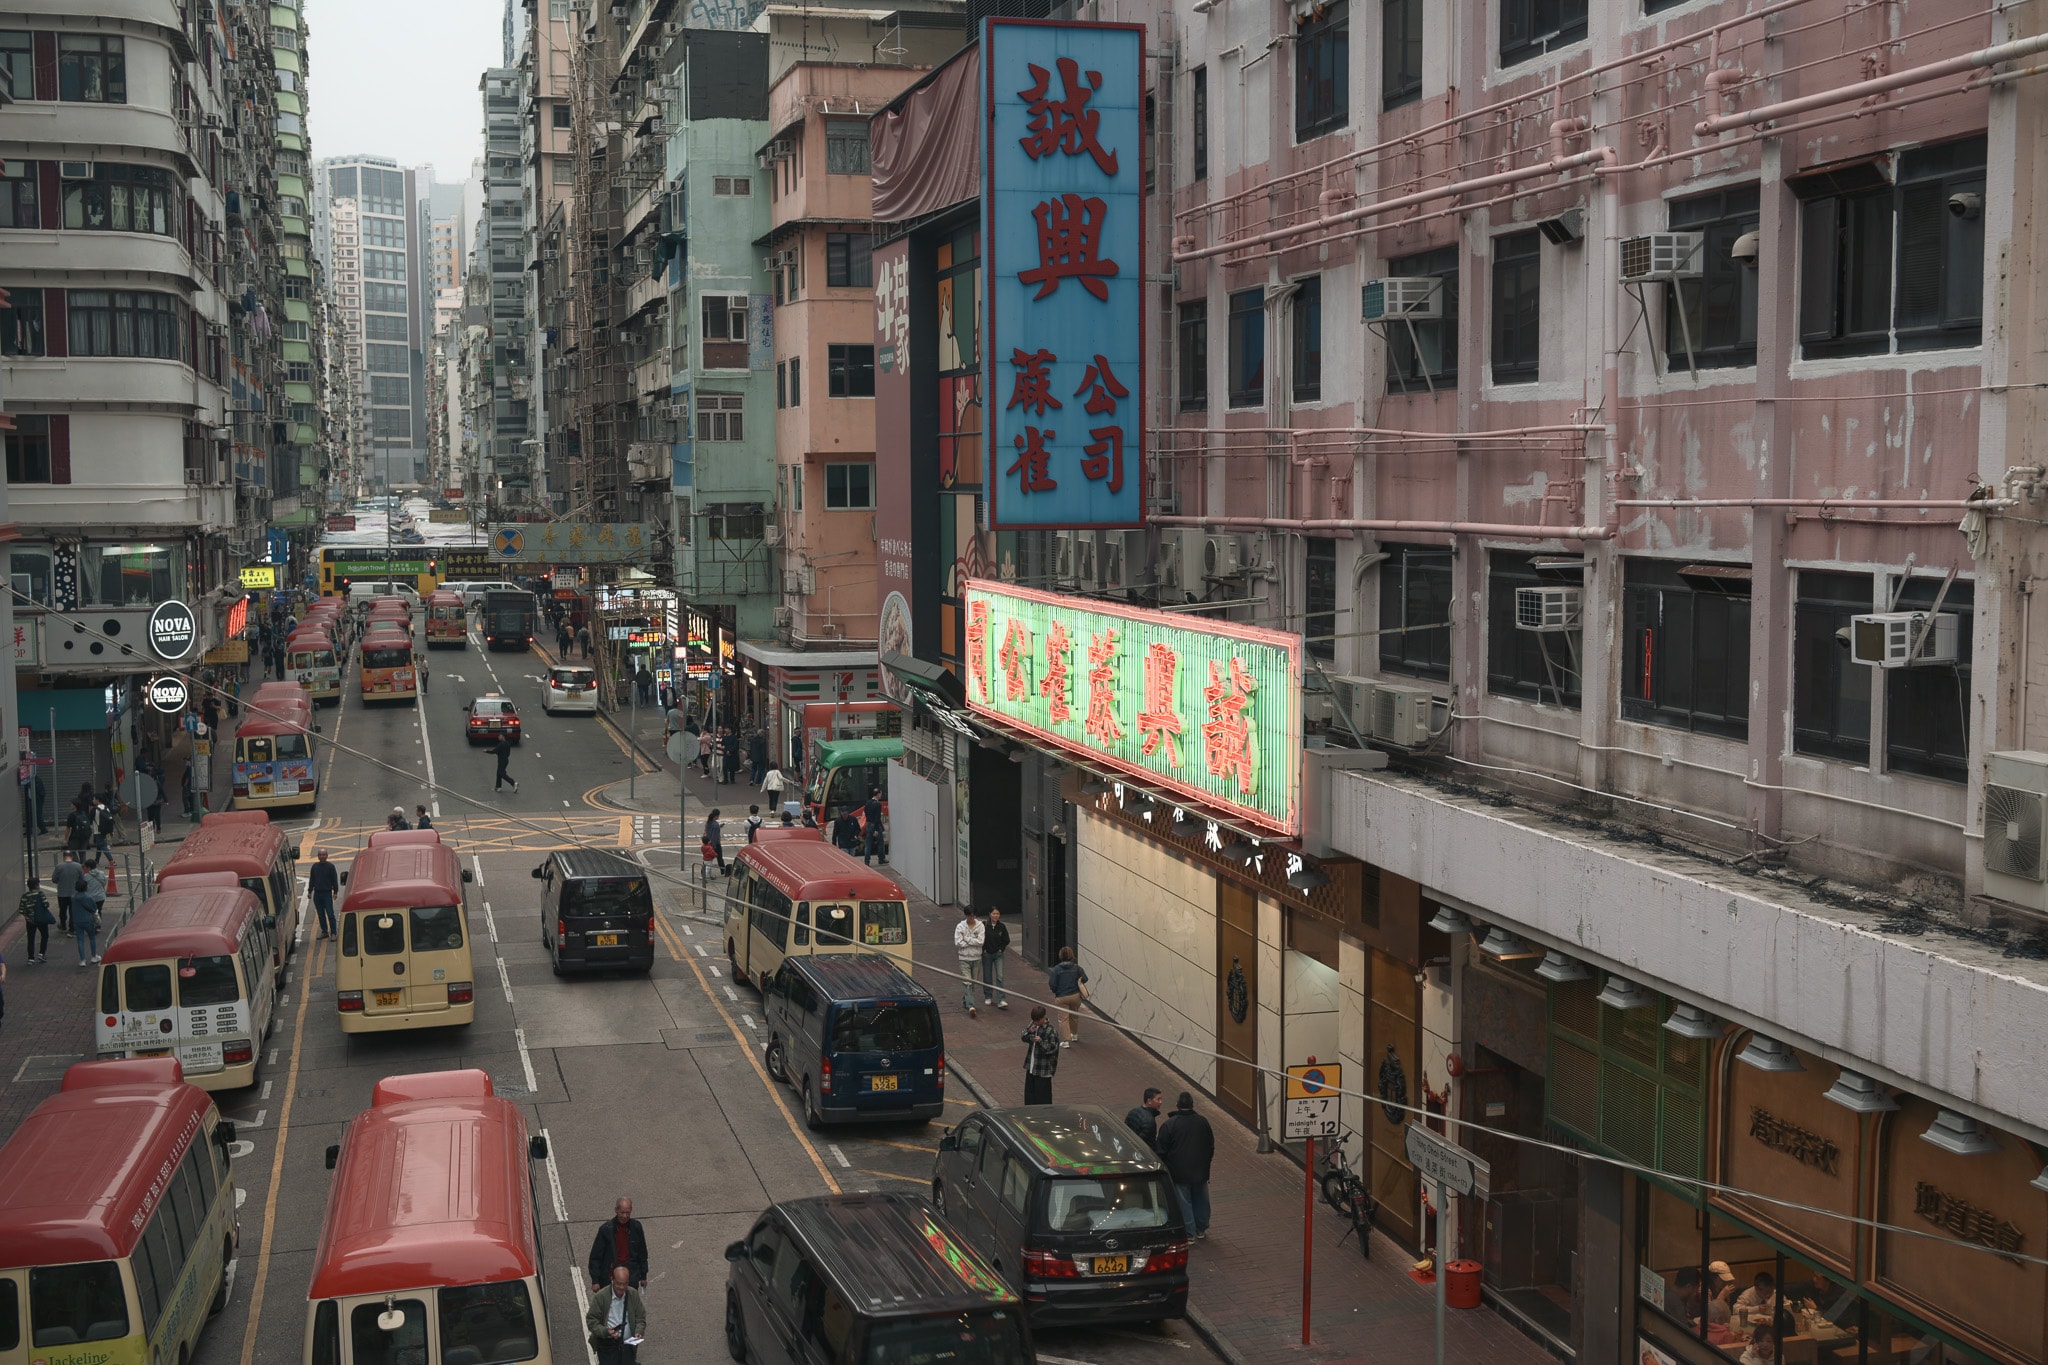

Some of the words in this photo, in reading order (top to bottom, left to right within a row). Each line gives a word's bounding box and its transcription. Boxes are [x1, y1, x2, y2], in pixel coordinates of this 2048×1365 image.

[1017, 57, 1119, 302] 誠興
[1073, 354, 1130, 493] 公司
[154, 617, 191, 633] NOVA
[171, 634, 189, 642] SALON
[153, 687, 184, 698] NOVA
[874, 1082, 896, 1090] 3245
[1295, 1106, 1311, 1114] 上午
[1320, 1100, 1329, 1113] 7
[1295, 1127, 1310, 1135] 午夜
[1320, 1121, 1336, 1134] 12
[1440, 1151, 1458, 1168] Street
[131, 1207, 146, 1231] PUBLIC
[142, 1191, 154, 1213] LIGHT
[150, 1182, 160, 1198] BUS
[160, 1160, 172, 1180] SEATS
[1914, 1181, 2024, 1265] 地道美食
[1104, 1256, 1117, 1264] VK
[1097, 1263, 1124, 1272] 6642
[49, 1352, 108, 1365] Jackeline
